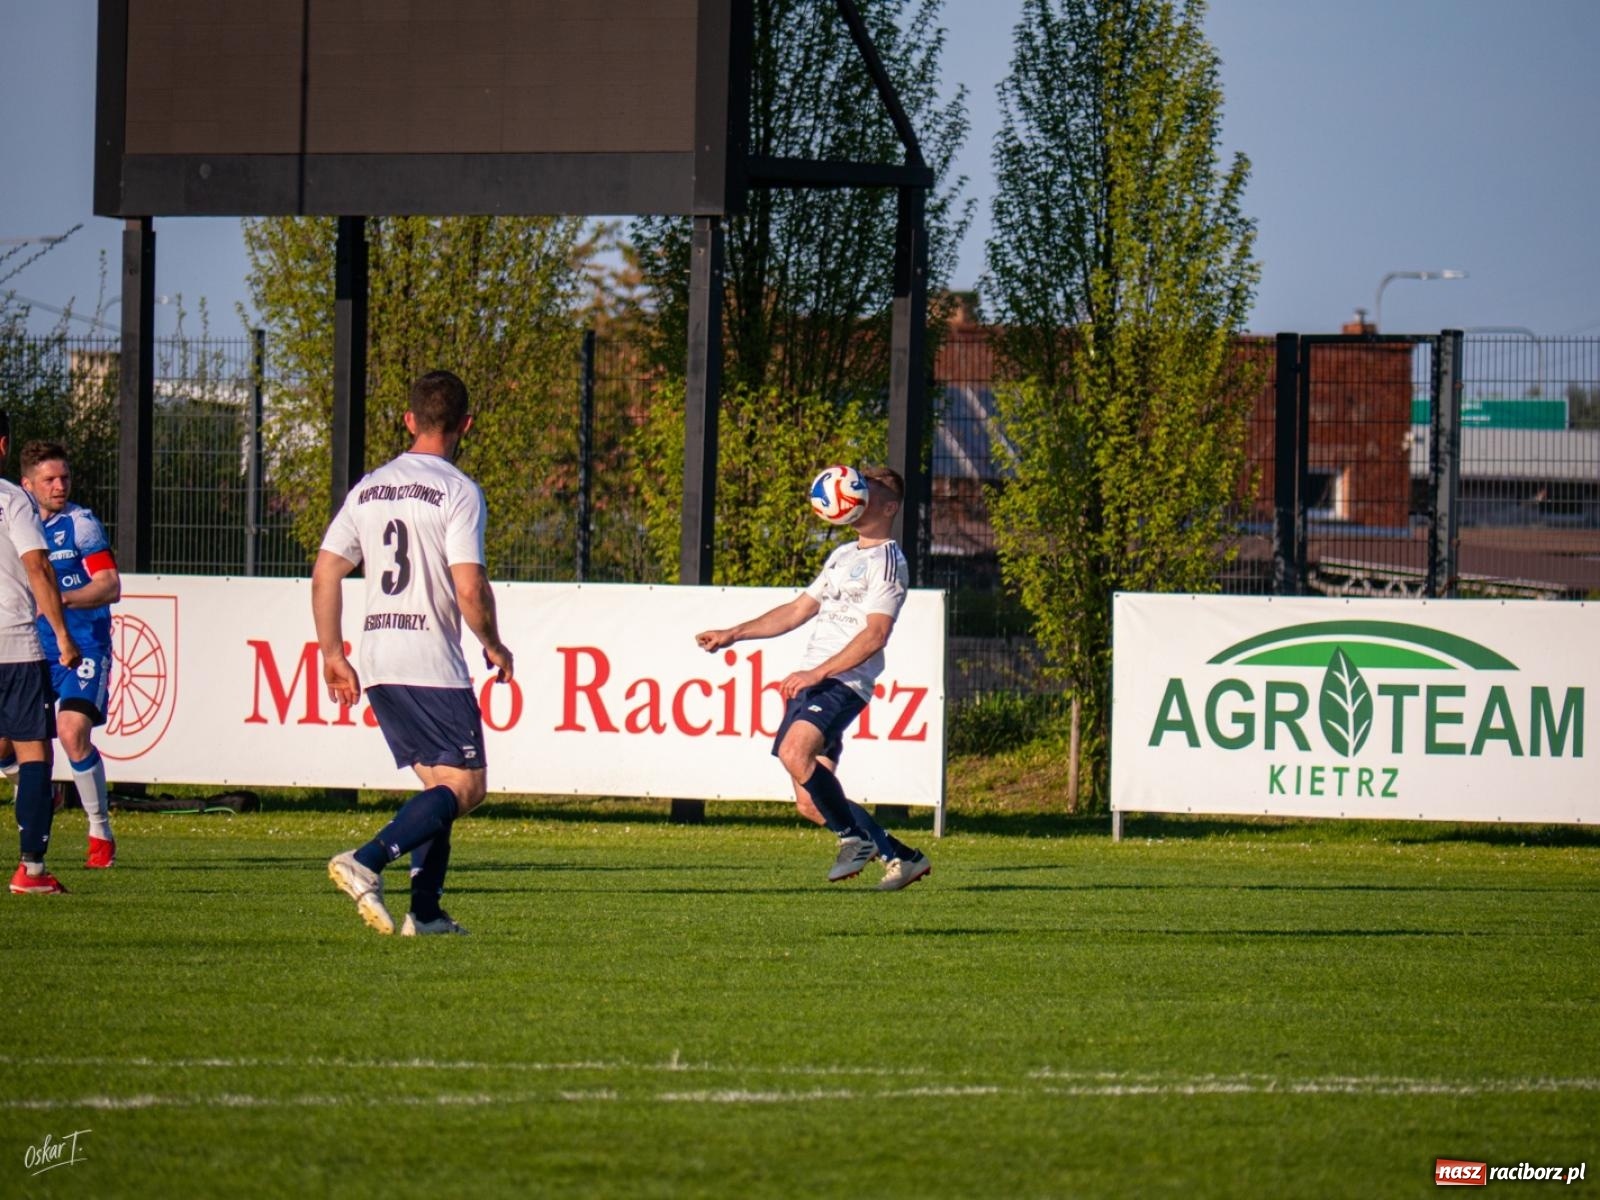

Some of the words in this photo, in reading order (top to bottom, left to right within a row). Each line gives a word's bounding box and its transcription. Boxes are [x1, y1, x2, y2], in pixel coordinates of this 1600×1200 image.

[381, 518, 411, 596] 3
[62, 573, 82, 587] Oil
[76, 657, 96, 680] 8
[1268, 764, 1399, 798] KIETRZ
